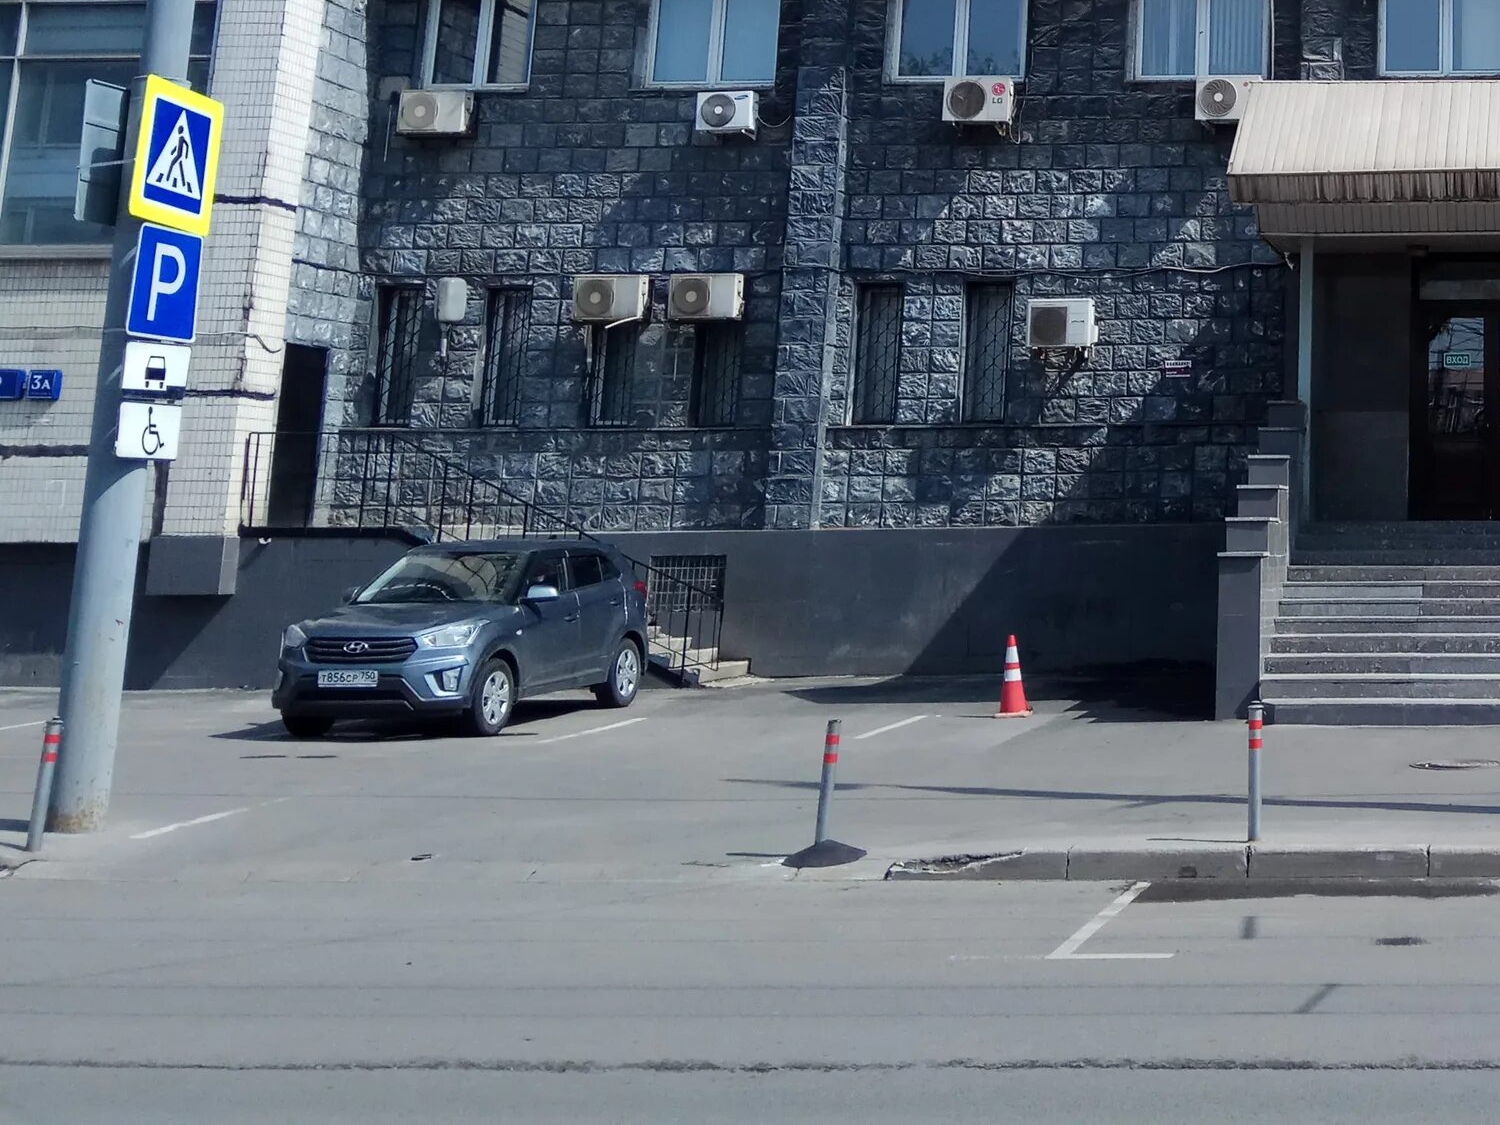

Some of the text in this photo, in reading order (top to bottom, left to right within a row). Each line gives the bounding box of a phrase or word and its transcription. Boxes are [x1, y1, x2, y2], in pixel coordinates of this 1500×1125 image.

[146, 242, 187, 322] P
[1446, 355, 1469, 364] ВХОД
[31, 375, 51, 390] 3А
